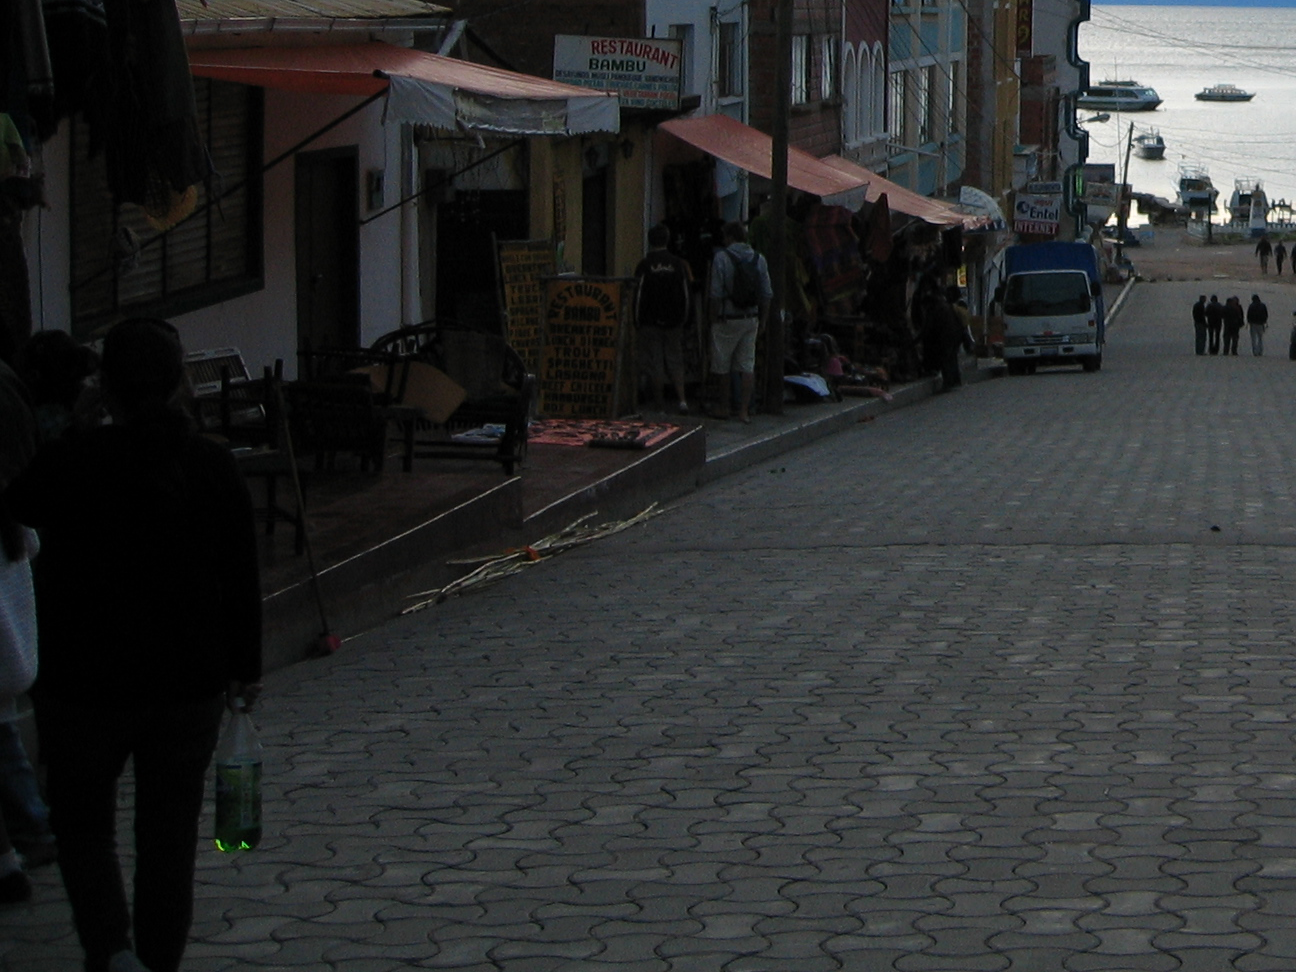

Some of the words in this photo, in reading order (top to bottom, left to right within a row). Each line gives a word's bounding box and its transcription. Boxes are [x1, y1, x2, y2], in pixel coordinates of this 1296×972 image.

[591, 39, 678, 69] RESTAURANT
[589, 58, 647, 72] BAMBU
[1029, 206, 1059, 220] Entel
[1014, 220, 1058, 234] INTERNET
[548, 284, 617, 320] RESTAURANT
[564, 306, 600, 321] BAMBU
[549, 323, 614, 336] BREAKFAST
[554, 347, 600, 357] TROUT
[548, 358, 614, 370] SPAGHETTI
[546, 371, 606, 382] LASAGNA
[571, 381, 612, 392] CHICKEN
[544, 392, 608, 403] HAMBURGER
[571, 403, 607, 414] LUNCH
